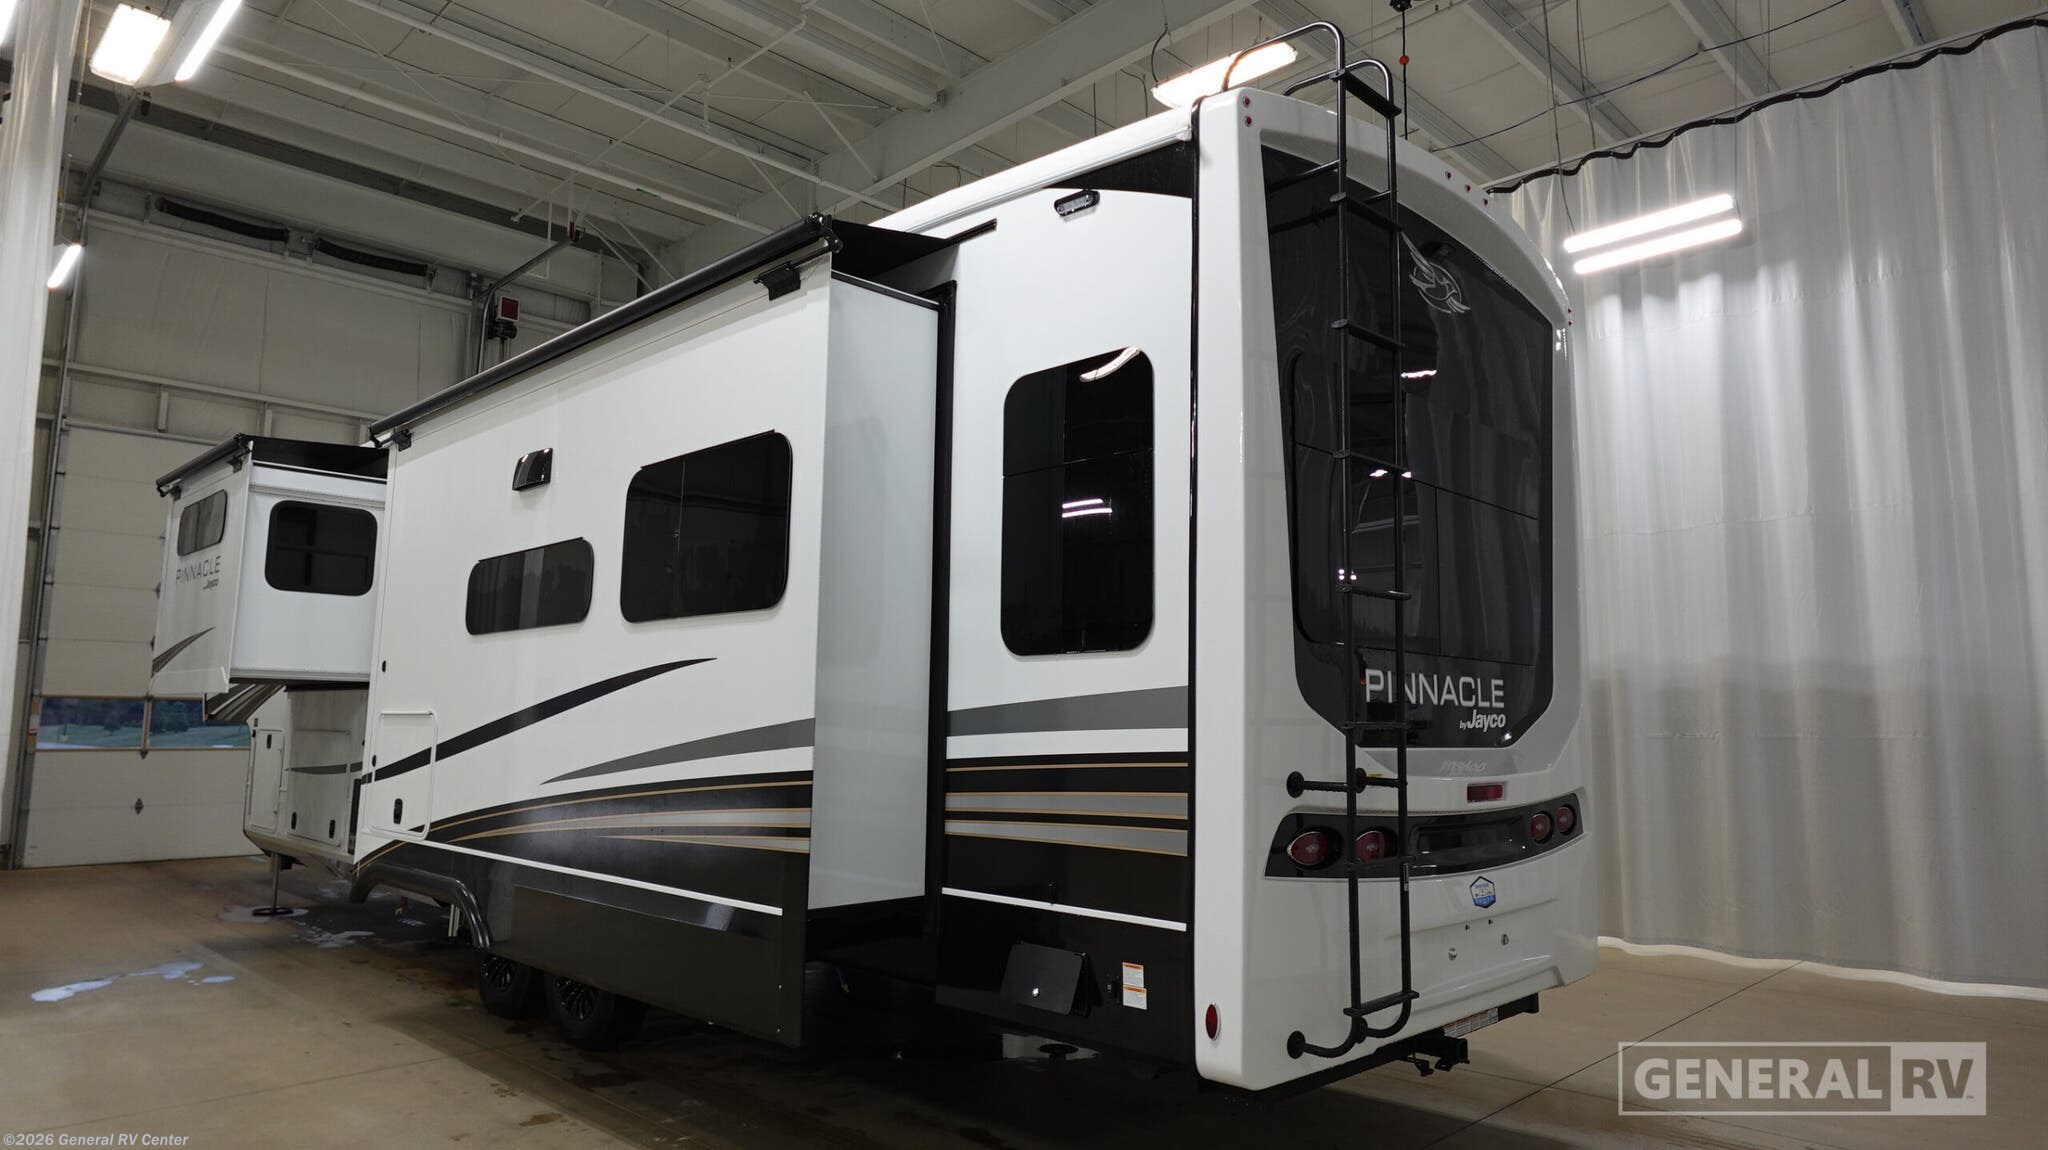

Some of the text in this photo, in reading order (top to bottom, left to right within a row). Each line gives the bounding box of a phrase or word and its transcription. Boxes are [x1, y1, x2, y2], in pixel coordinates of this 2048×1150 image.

[1365, 668, 1505, 708] PINNACLE
[1459, 709, 1506, 732] by Jayco
